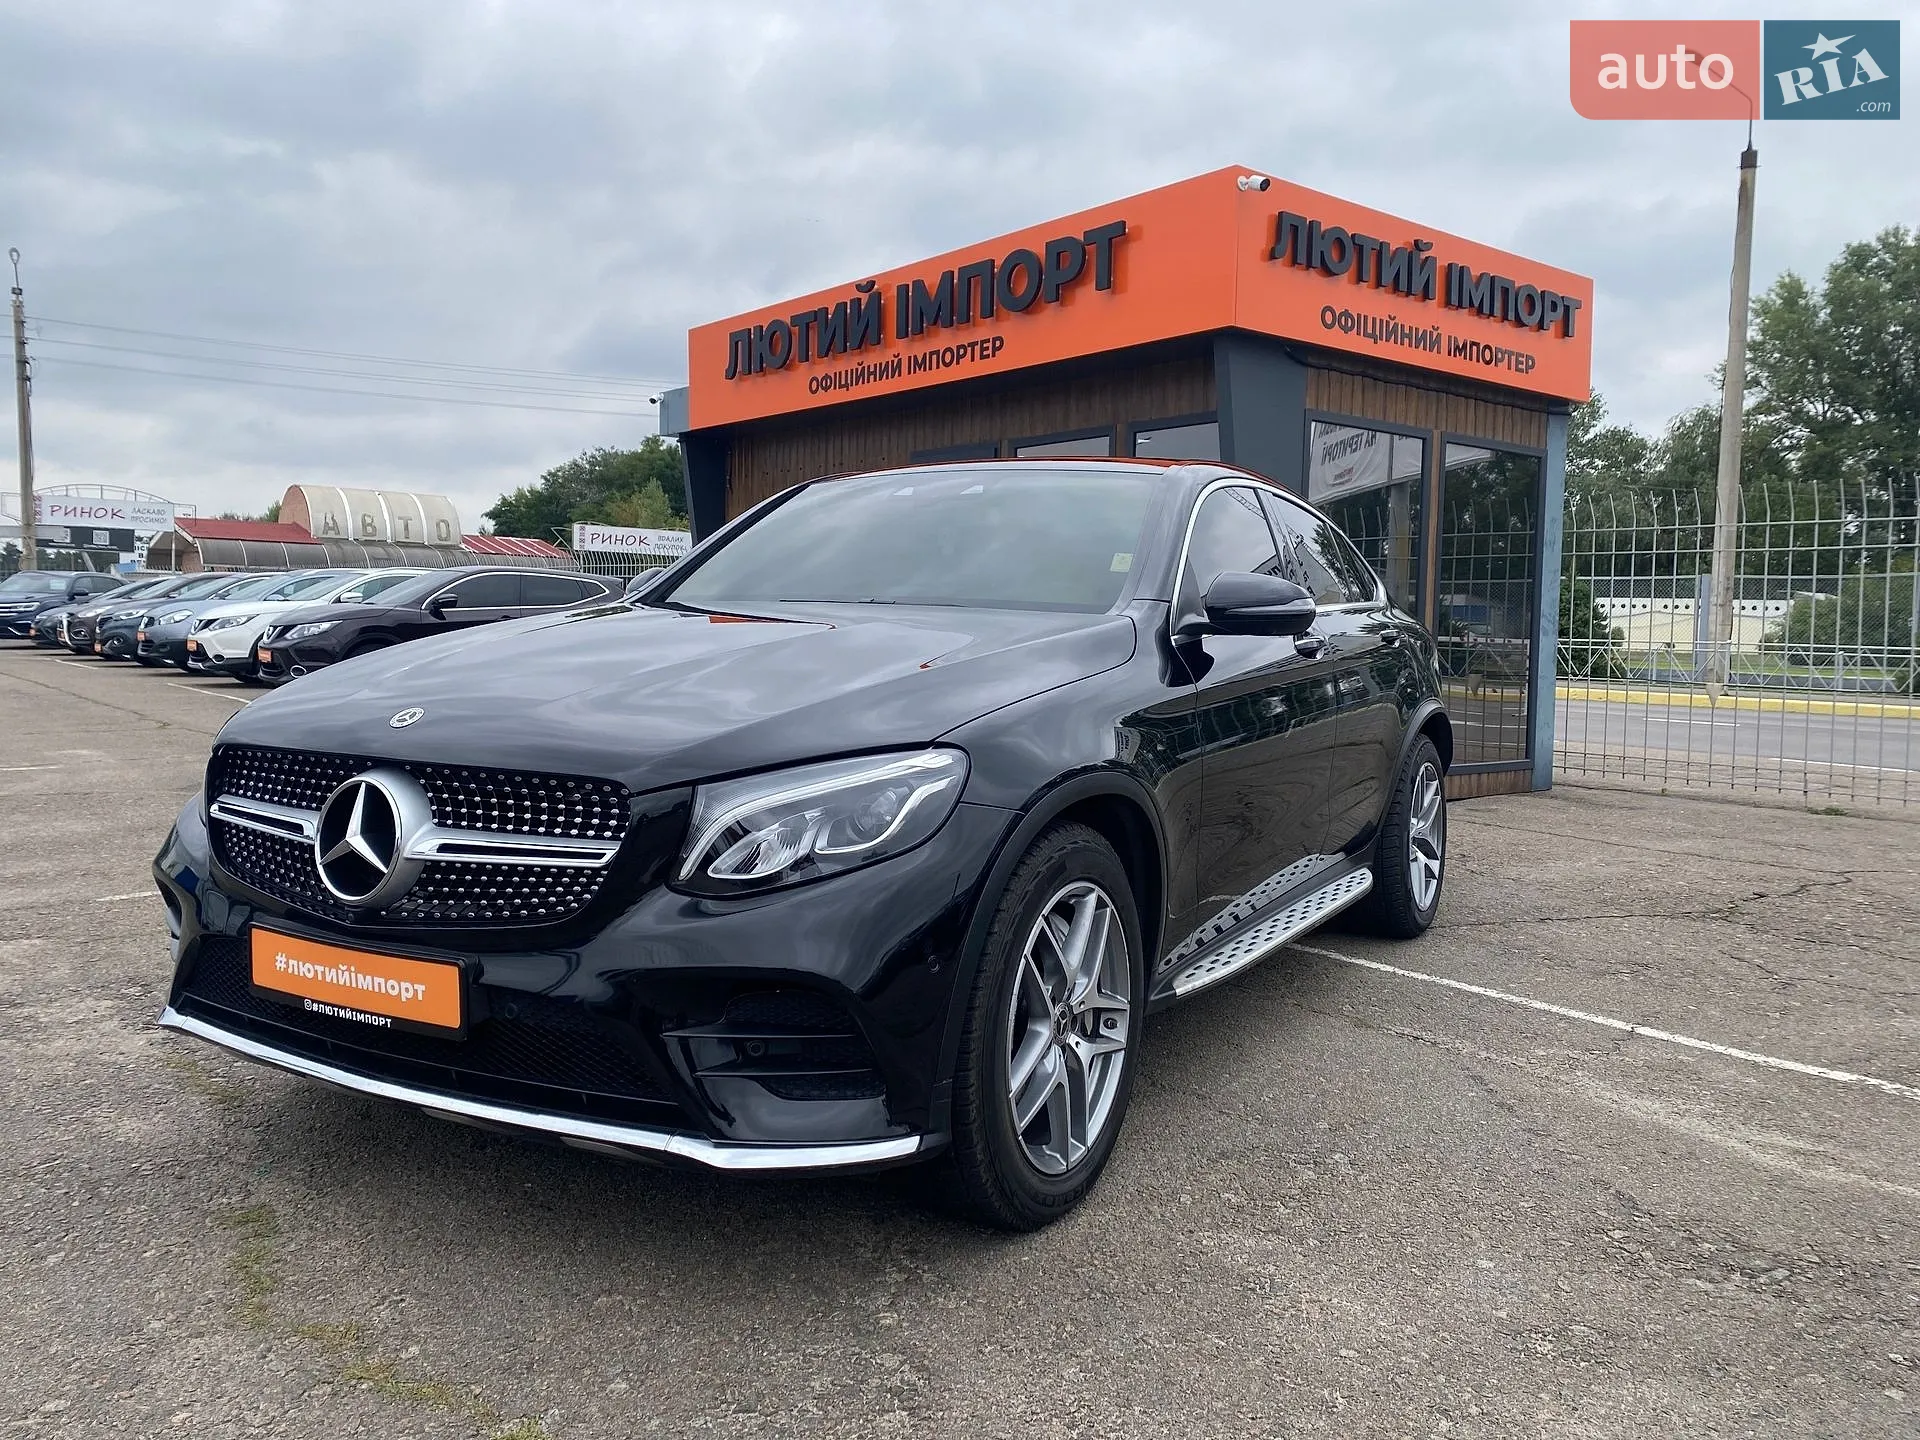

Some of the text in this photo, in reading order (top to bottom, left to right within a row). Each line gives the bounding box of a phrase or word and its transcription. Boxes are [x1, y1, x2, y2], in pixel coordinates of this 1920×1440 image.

[725, 219, 1128, 380] ЛЮТИЙ ІМПОРТ
[1270, 210, 1582, 338] ЛЮТИЙ ІМПОРТ
[808, 335, 1004, 395] ОФІЦІЙНИЙ ІМПОРТЕР
[1320, 305, 1536, 374] ОФІЦІЙНИЙ ІМПОРТЕР
[49, 504, 125, 519] РИНОК
[590, 532, 650, 546] РИНОК
[275, 952, 426, 1002] #лютийімпорт
